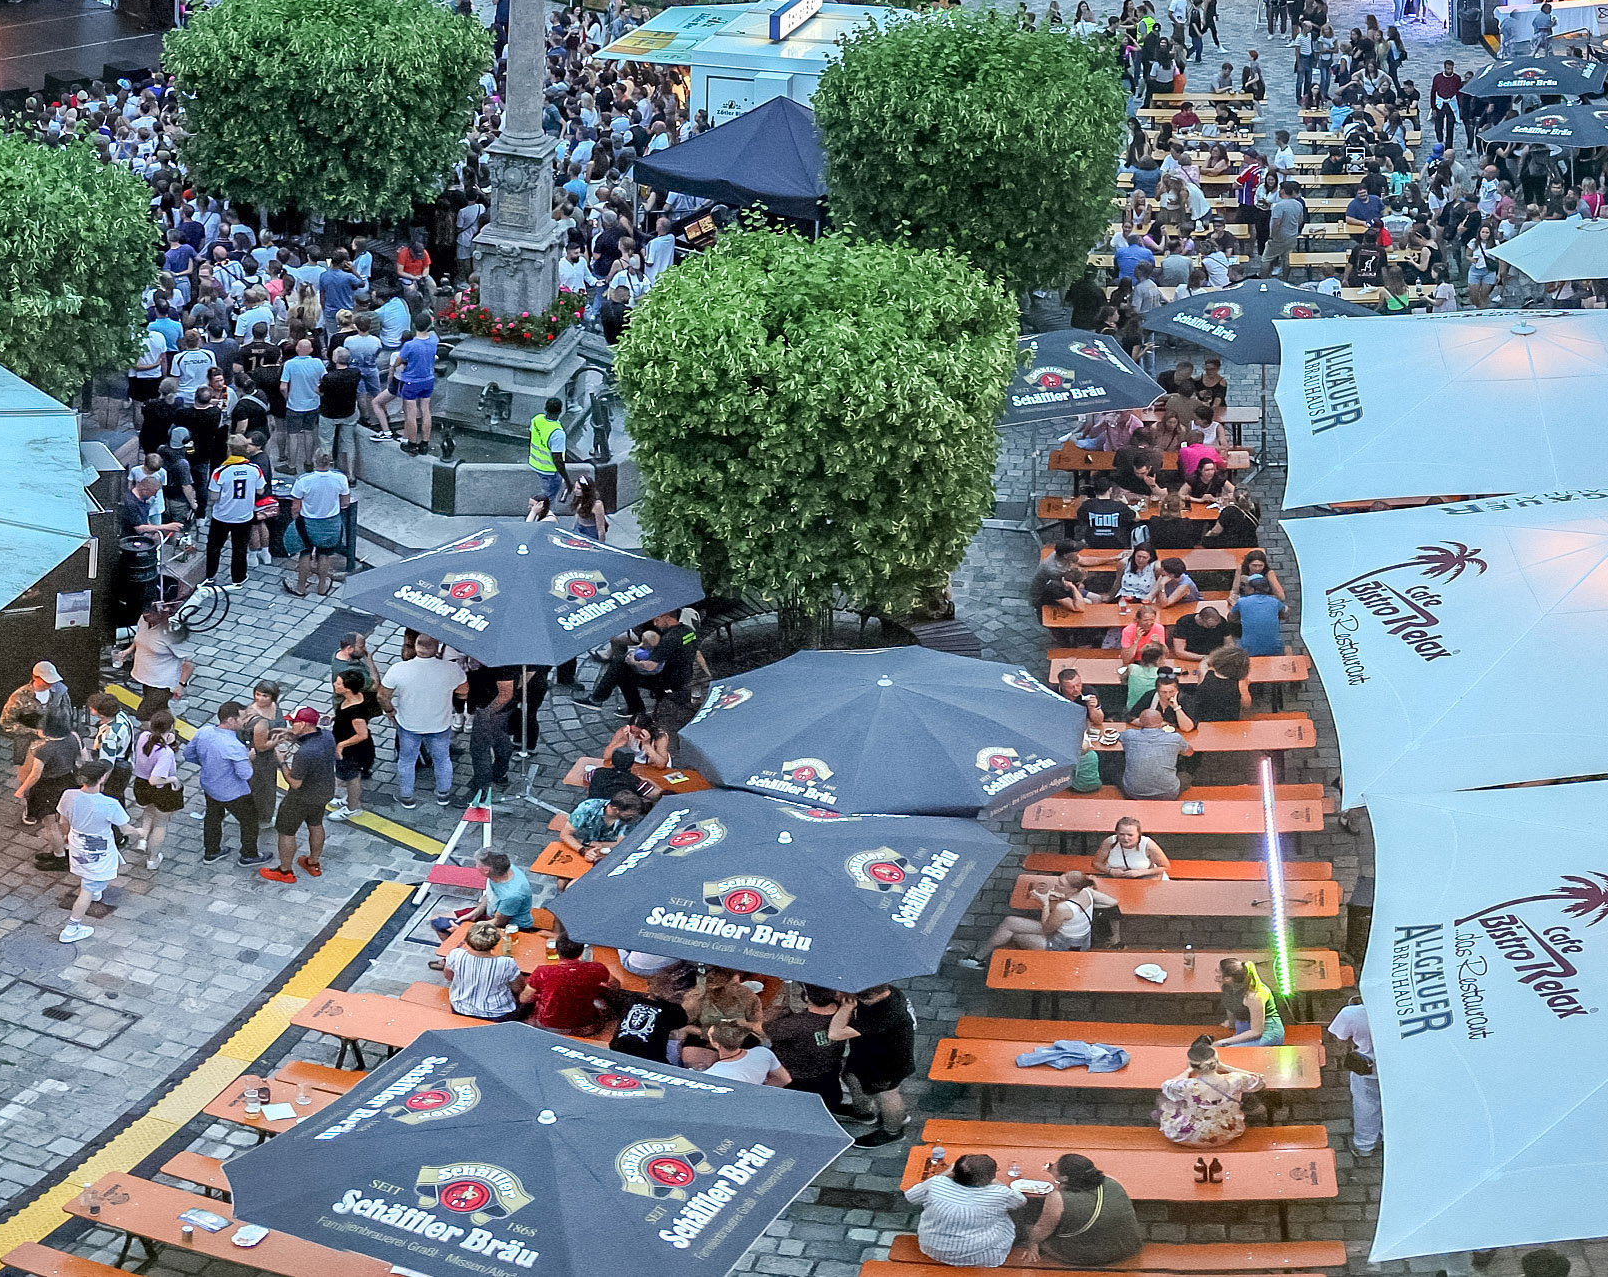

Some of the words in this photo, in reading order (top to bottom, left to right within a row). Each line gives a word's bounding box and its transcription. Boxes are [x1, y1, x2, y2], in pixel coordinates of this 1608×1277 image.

[1172, 312, 1215, 334] Schäffler
[1211, 326, 1238, 343] Bräu
[1011, 388, 1070, 407] Schäffler
[1072, 385, 1107, 400] Bräu
[1303, 362, 1326, 417] BRAUHAUS
[1304, 342, 1364, 436] ALLGÄUER
[233, 479, 246, 500] 8
[393, 584, 457, 621] Schäffler
[452, 608, 490, 632] Bräu
[557, 602, 616, 632] Schäffler
[614, 583, 654, 607] Bräu
[1404, 585, 1443, 608] Cafe
[1346, 580, 1400, 617] Bistro
[1381, 606, 1453, 662] Relax
[1330, 614, 1371, 686] Restaurant
[746, 774, 803, 798] Schäffler
[803, 787, 838, 806] Bräu
[982, 770, 1027, 797] Schäffler
[1023, 757, 1058, 776] Bräu
[669, 895, 696, 908] SEIT
[717, 877, 784, 901] Schäffler
[891, 876, 939, 929] Schäffler
[920, 849, 960, 881] Bräu
[638, 927, 711, 951] Familienbrauerei
[645, 906, 751, 940] Schäffler
[753, 916, 813, 951] Bräu
[781, 916, 807, 927] 1868
[1542, 926, 1584, 954] Cafe
[1391, 944, 1415, 1017] BRAUHAUS
[1394, 923, 1454, 1040] ALLGÄUER
[1478, 914, 1535, 961] Bistro
[1513, 952, 1589, 1020] Relax
[1456, 955, 1495, 1040] Restaurant
[622, 1141, 677, 1184] Schäffler
[713, 1138, 735, 1156] 1868
[369, 1178, 405, 1196] SEIT
[438, 1165, 517, 1200] Schäffler
[658, 1178, 738, 1250] Schäffler
[717, 1142, 777, 1187] Bräu
[332, 1189, 464, 1243] Schäffler
[458, 1227, 540, 1268] Bräu
[507, 1222, 538, 1238] 1868
[644, 1205, 668, 1224] SEIT
[316, 1215, 407, 1248] Familienbrauerei
[407, 1240, 438, 1258] Graßl
